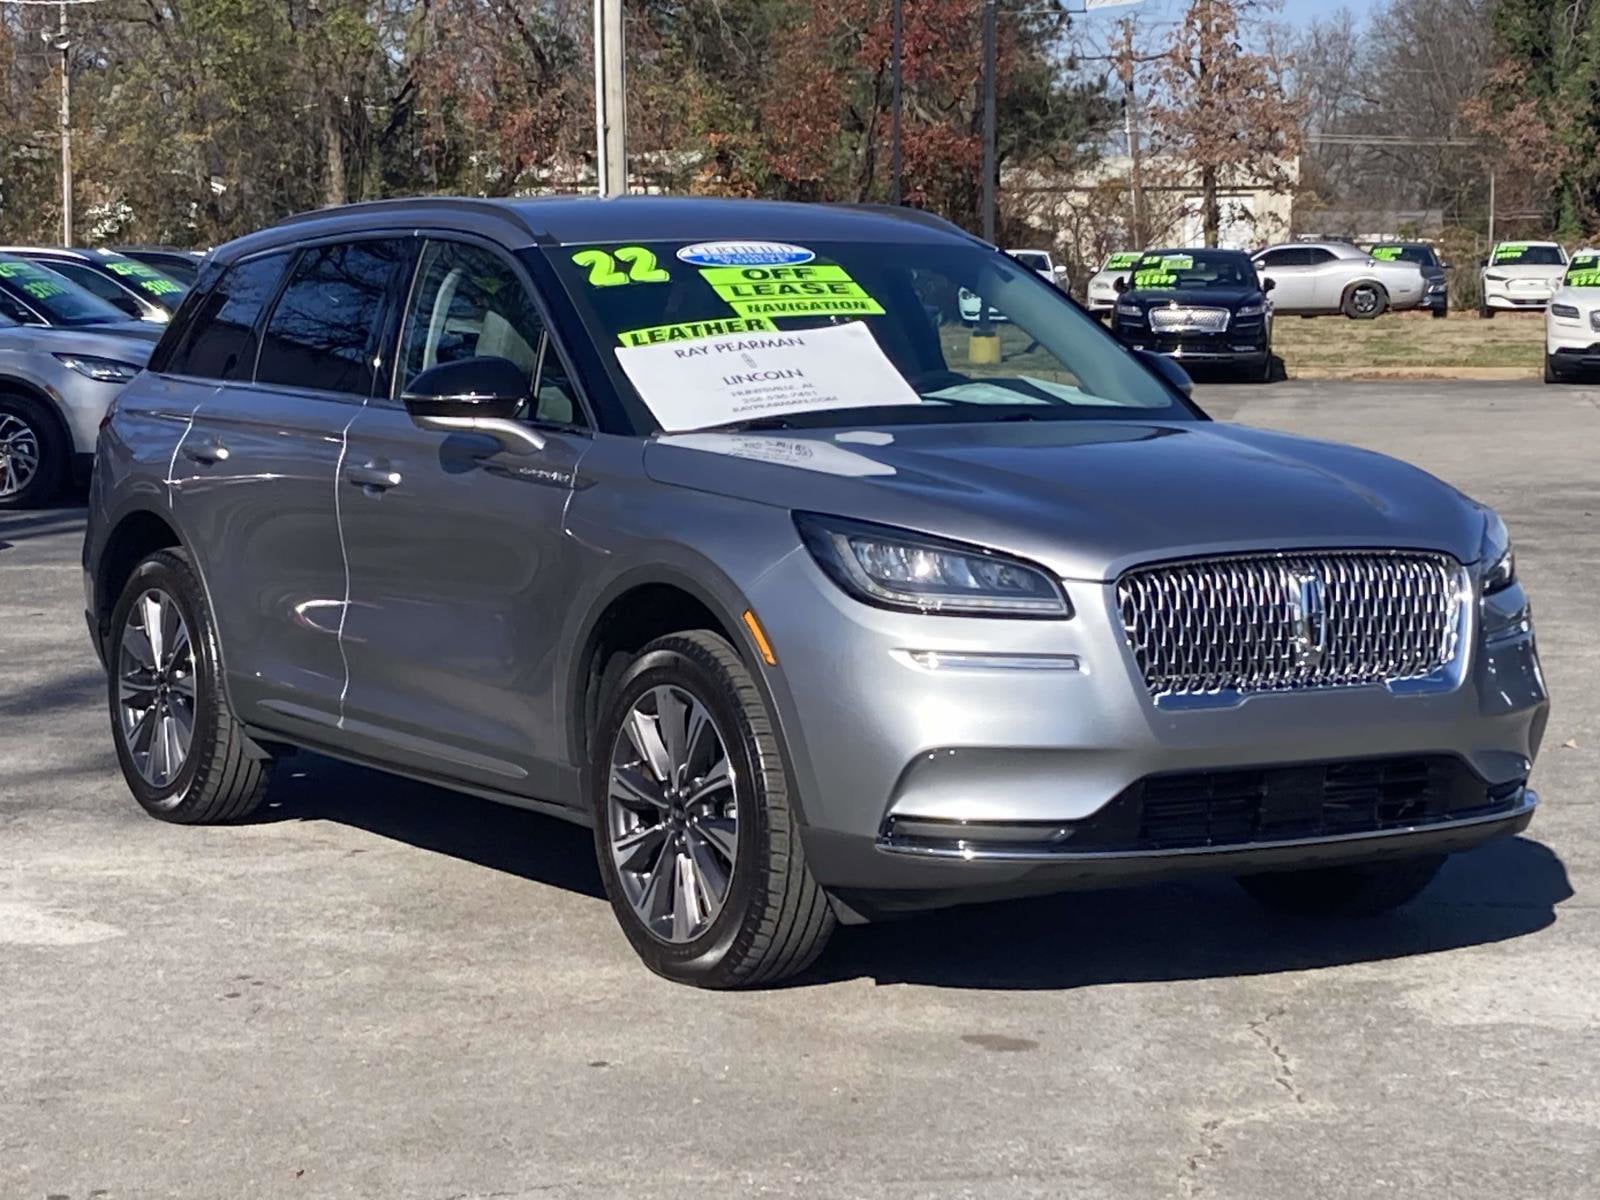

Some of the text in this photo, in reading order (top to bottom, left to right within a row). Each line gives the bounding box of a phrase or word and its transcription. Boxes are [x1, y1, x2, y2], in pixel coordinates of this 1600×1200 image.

[571, 247, 670, 286] 22
[740, 267, 815, 281] OFF
[730, 282, 852, 298] LEASE
[747, 301, 868, 314] NAVIGATION
[630, 317, 765, 346] LEATHER
[673, 336, 806, 359] RAY PEARMAN
[722, 368, 805, 386] LINCOLN
